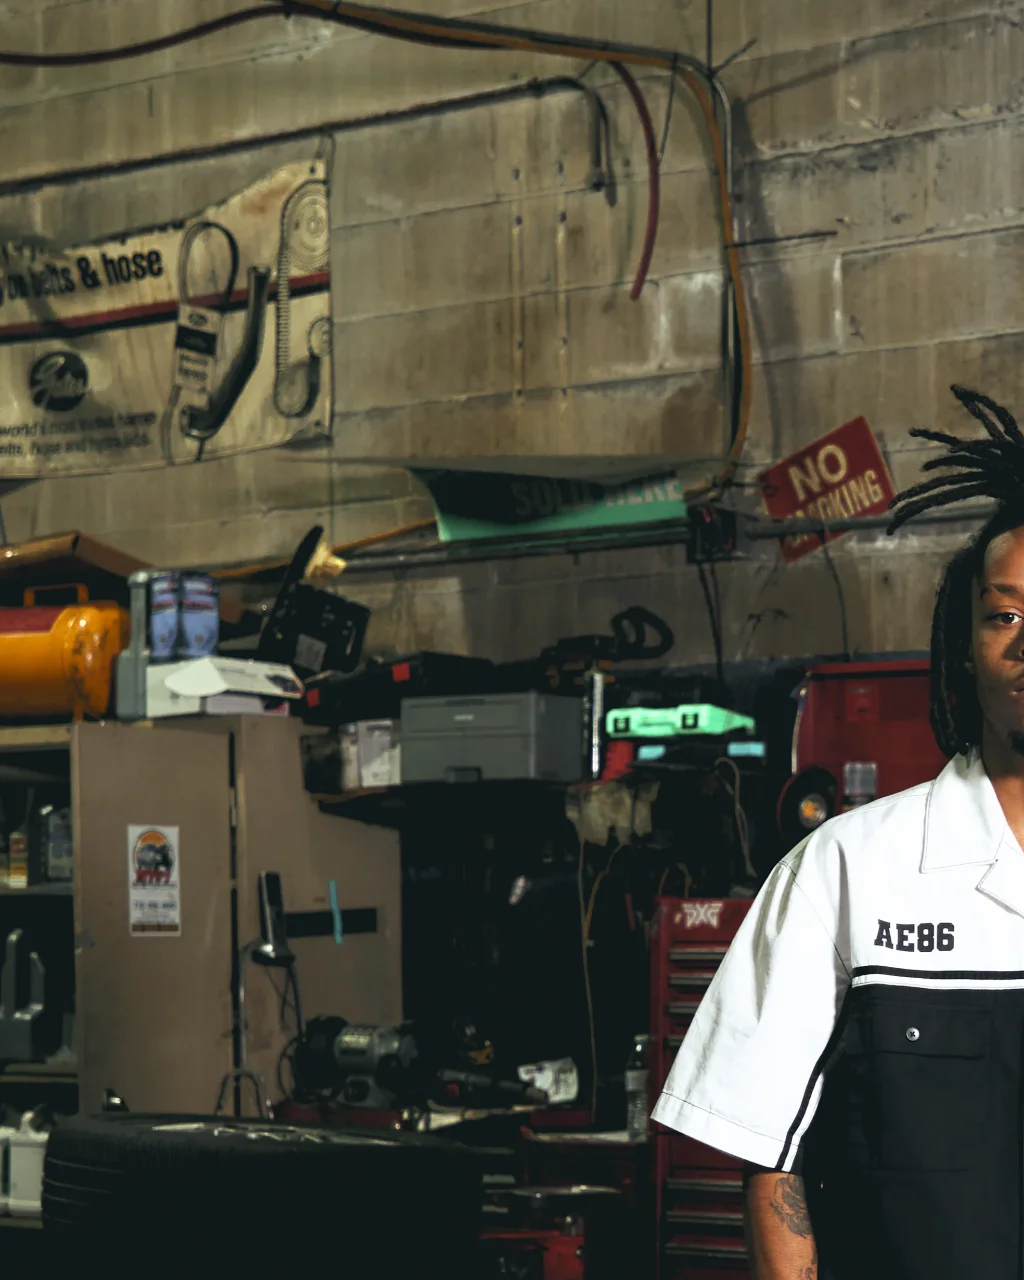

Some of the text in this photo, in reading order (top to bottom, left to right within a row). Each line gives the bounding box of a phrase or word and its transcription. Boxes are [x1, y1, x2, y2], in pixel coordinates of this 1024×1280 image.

[77, 256, 101, 290] &
[101, 249, 164, 287] hose
[788, 444, 848, 502] NO
[874, 919, 955, 953] AE86
